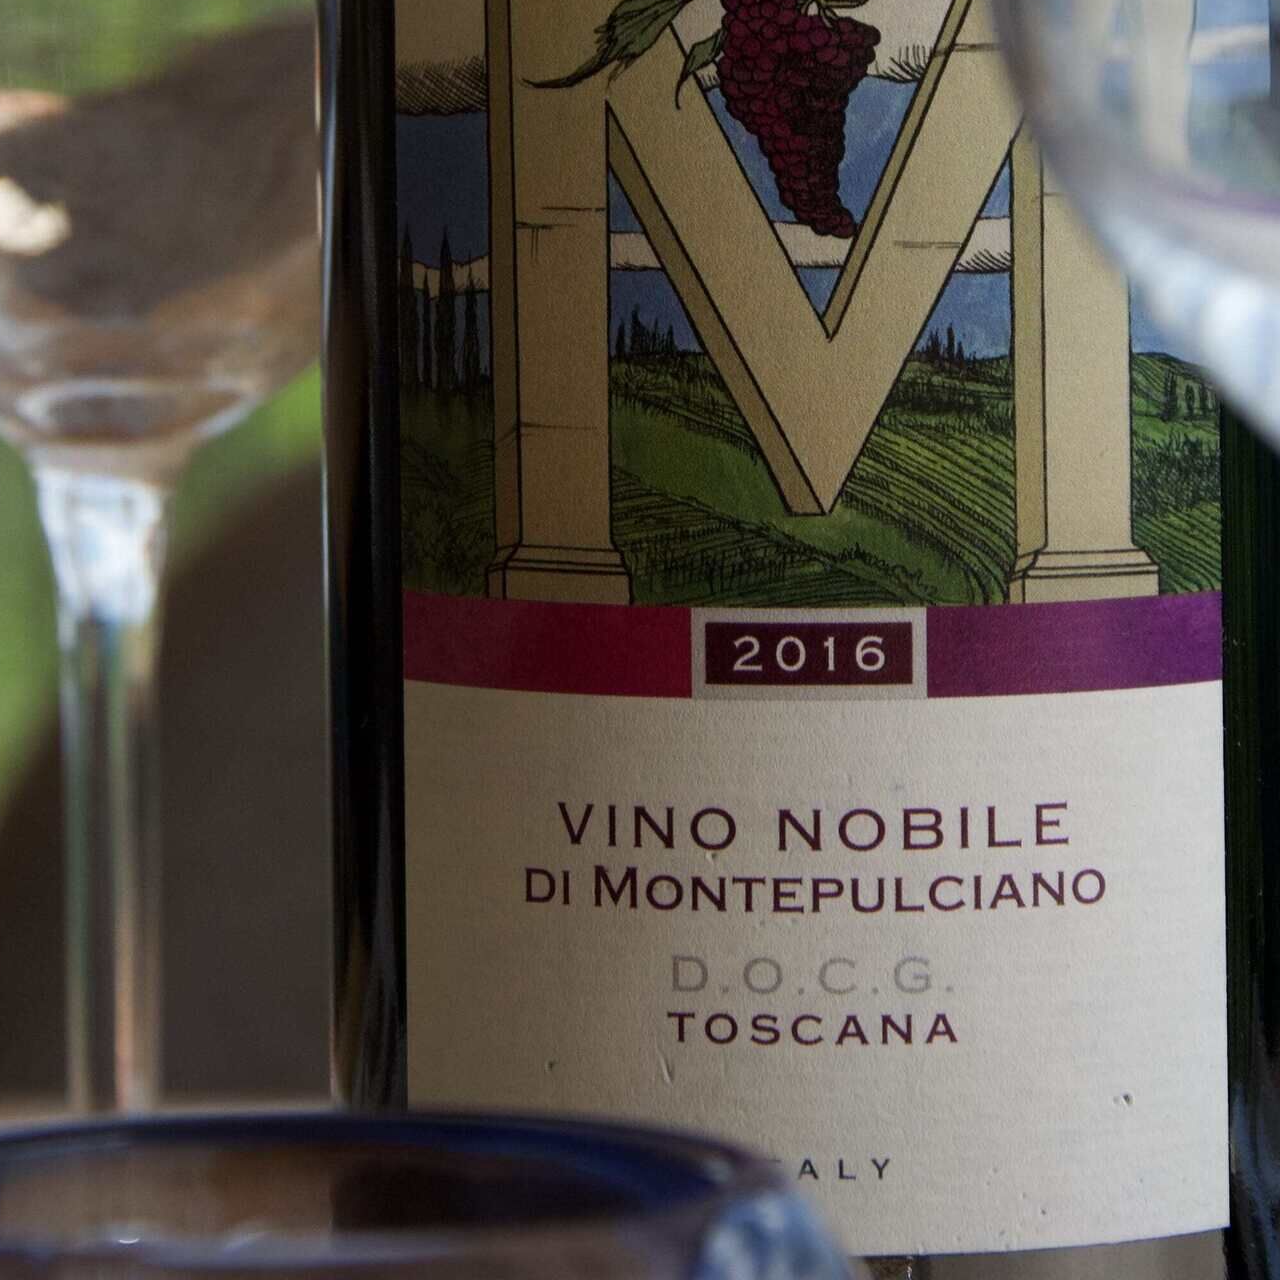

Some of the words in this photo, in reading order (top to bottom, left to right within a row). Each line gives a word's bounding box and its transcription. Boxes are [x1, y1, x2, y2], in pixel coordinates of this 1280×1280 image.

[732, 635, 886, 672] 2016
[557, 802, 737, 852] VINO
[777, 801, 1070, 852] NOBILE
[524, 867, 571, 906] DI
[593, 865, 1107, 913] MONTEPULCIANO
[671, 955, 955, 995] D.O.C.G.
[667, 1011, 959, 1046] TOSCANA
[773, 1158, 890, 1180] ALY
